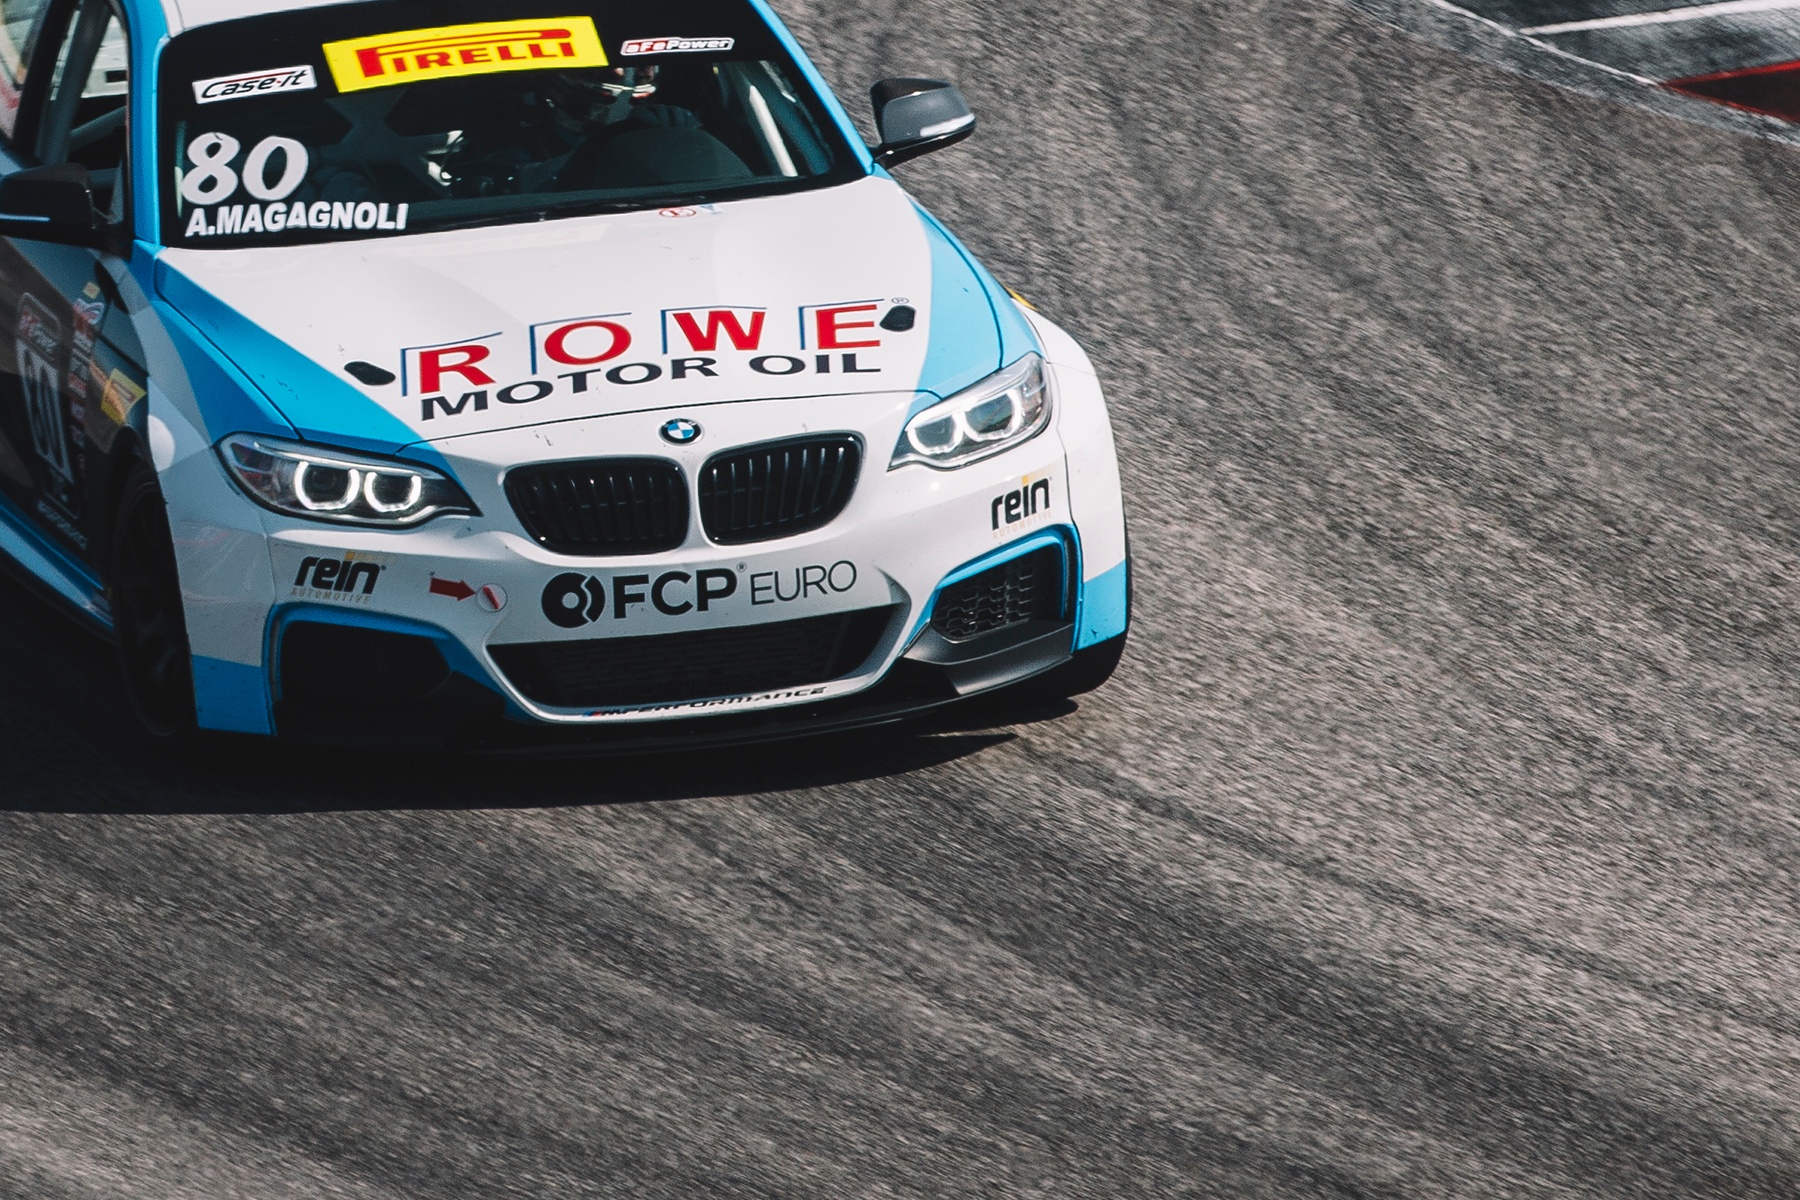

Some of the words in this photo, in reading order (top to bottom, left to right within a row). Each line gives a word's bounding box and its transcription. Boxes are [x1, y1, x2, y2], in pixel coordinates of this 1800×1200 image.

[356, 29, 575, 78] PIRELLI
[181, 132, 309, 206] 80
[184, 201, 409, 237] A.MAGAGNOLI
[419, 304, 882, 394] ROWE
[421, 356, 719, 421] MOTOR
[748, 352, 882, 376] OIL
[991, 474, 1050, 531] rein
[294, 552, 380, 595] rein
[612, 567, 738, 620] FCP
[750, 560, 857, 605] EURO
